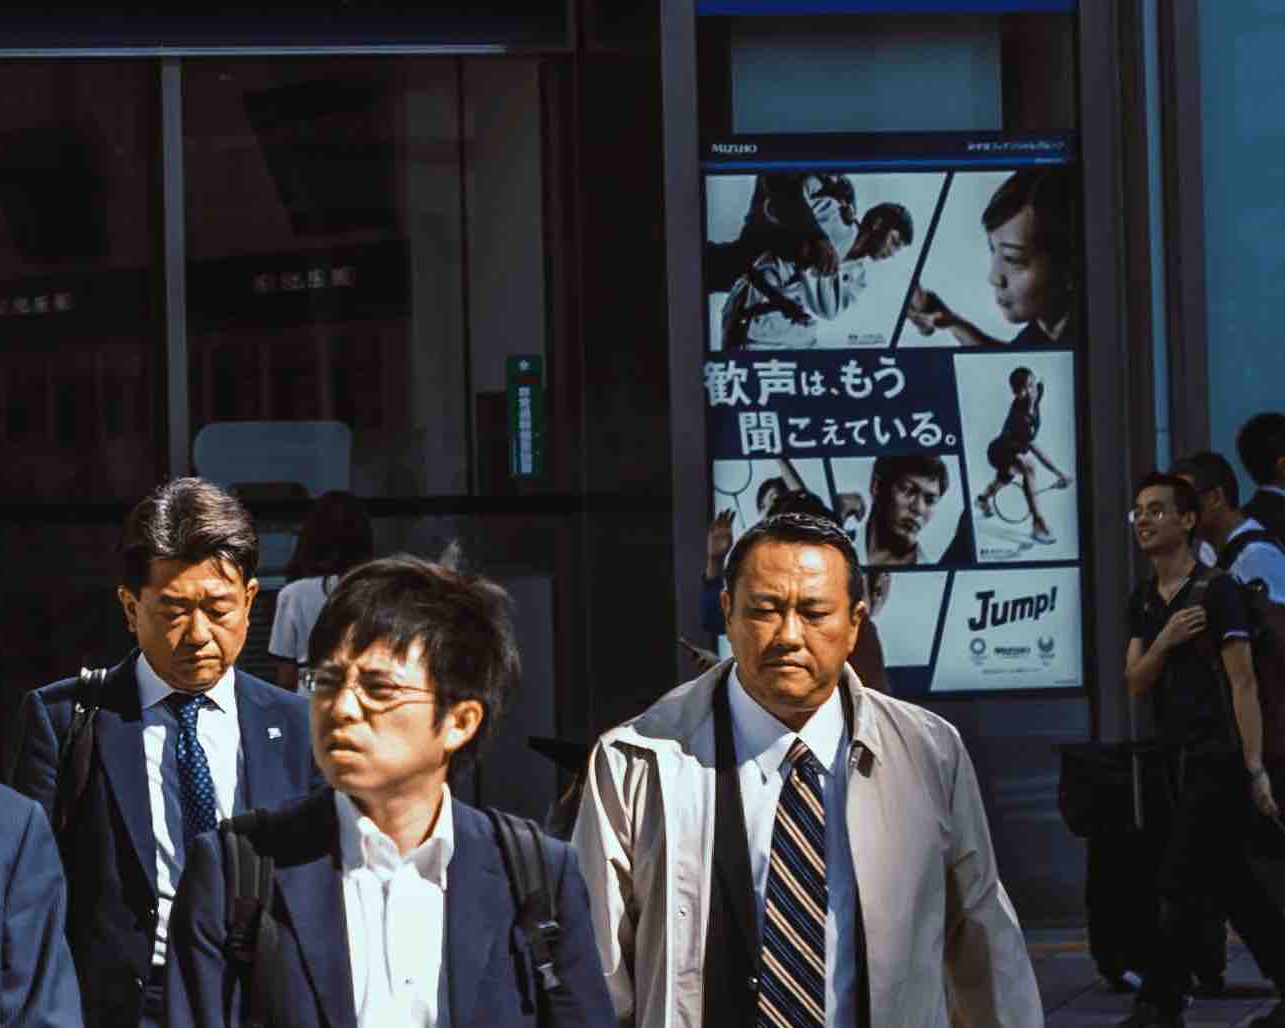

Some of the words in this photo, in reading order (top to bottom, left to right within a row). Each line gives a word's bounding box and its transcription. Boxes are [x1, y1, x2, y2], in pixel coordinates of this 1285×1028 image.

[704, 356, 906, 407] 歓声は、もう
[739, 411, 957, 455] 聞こえている。
[968, 585, 1058, 632] Jump!
